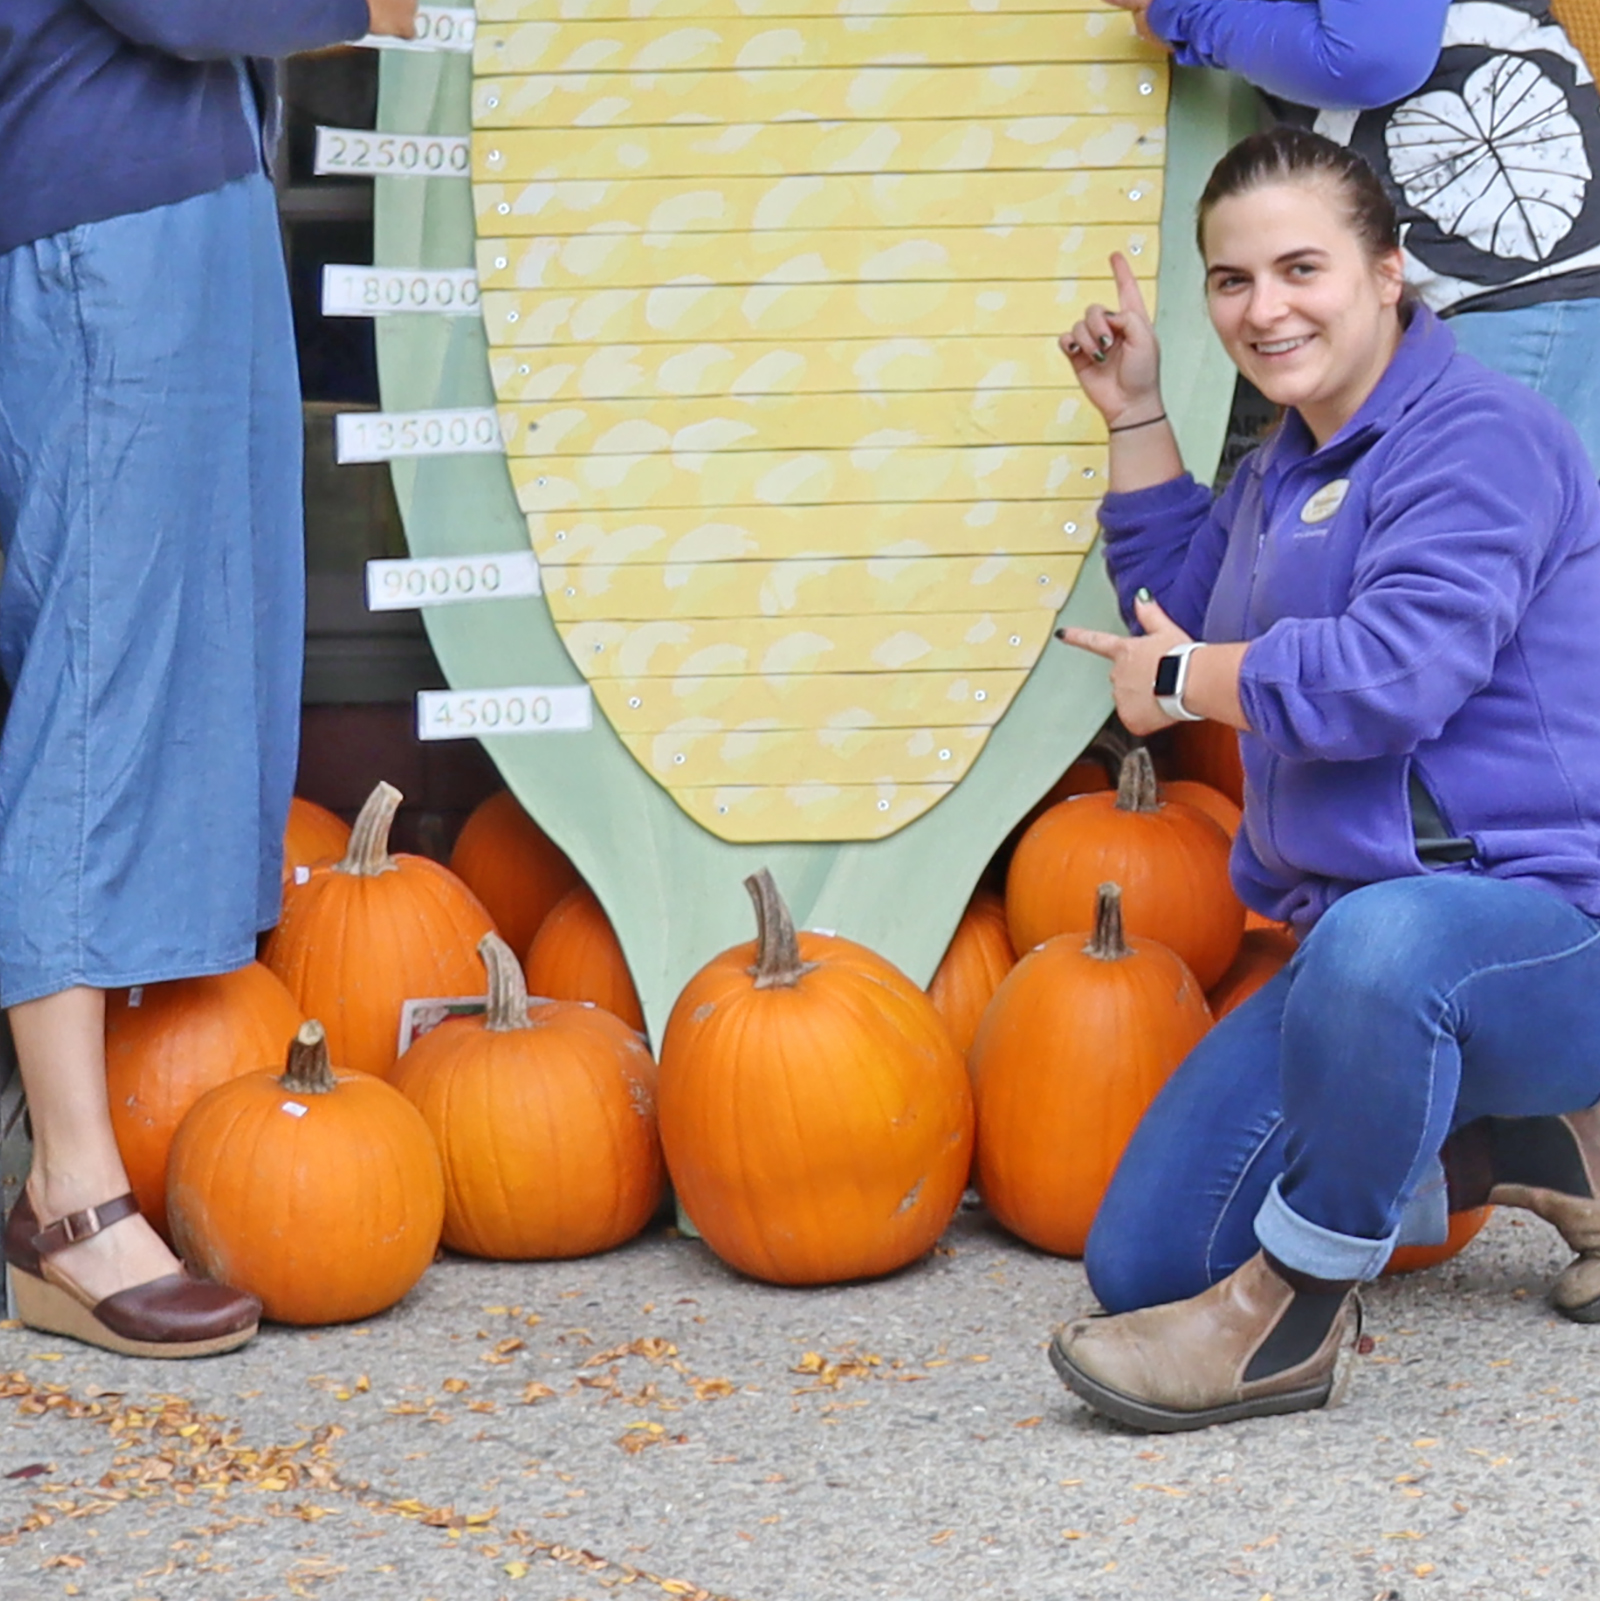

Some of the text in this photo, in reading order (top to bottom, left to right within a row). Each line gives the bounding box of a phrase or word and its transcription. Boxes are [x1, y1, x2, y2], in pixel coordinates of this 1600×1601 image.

[326, 136, 470, 170] 225000
[343, 275, 480, 307] 180000
[354, 416, 496, 451] 135000
[382, 563, 501, 598] 90000
[433, 695, 553, 729] 45000
